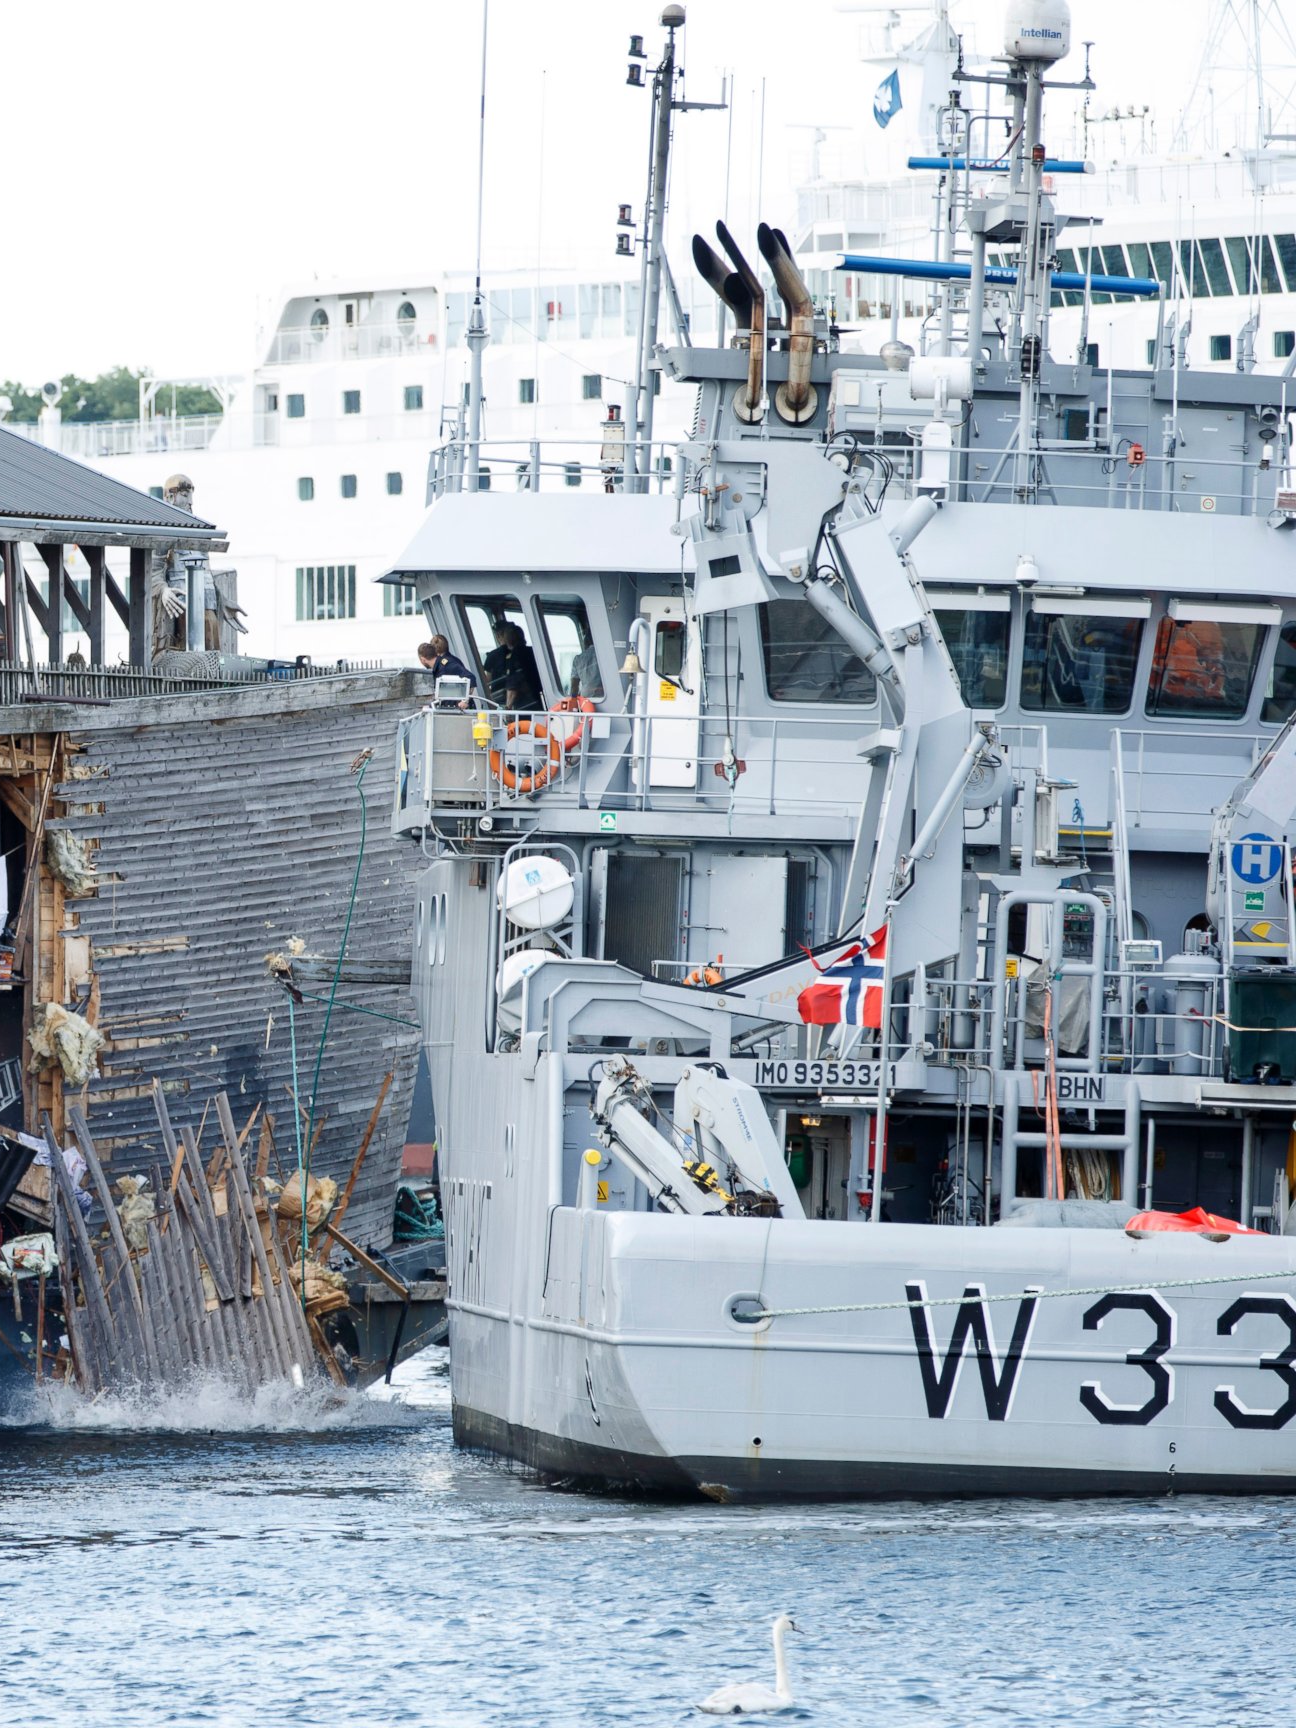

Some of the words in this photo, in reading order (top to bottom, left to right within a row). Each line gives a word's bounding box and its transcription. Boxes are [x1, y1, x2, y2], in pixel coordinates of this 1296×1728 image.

[1021, 28, 1062, 39] Intellian
[755, 1062, 788, 1084] IMO
[794, 1063, 896, 1086] 9353321
[1169, 1441, 1177, 1454] 6
